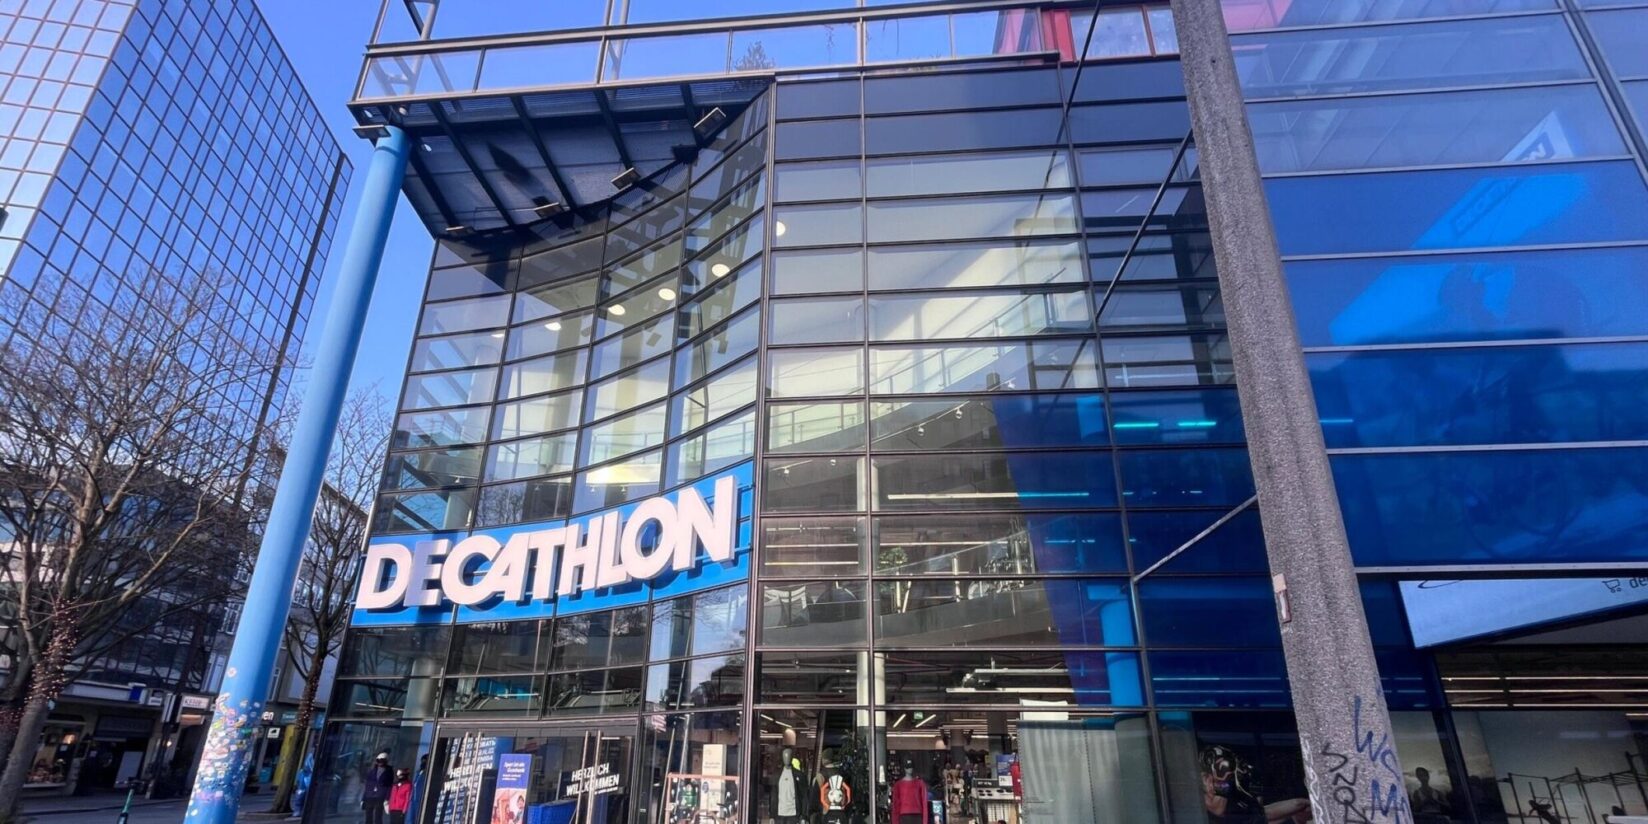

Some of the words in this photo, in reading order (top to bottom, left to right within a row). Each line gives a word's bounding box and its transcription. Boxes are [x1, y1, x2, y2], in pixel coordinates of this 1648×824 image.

[355, 475, 737, 611] DECATHLON
[571, 763, 610, 782] HERZLCH
[566, 774, 620, 796] WILKMMEN
